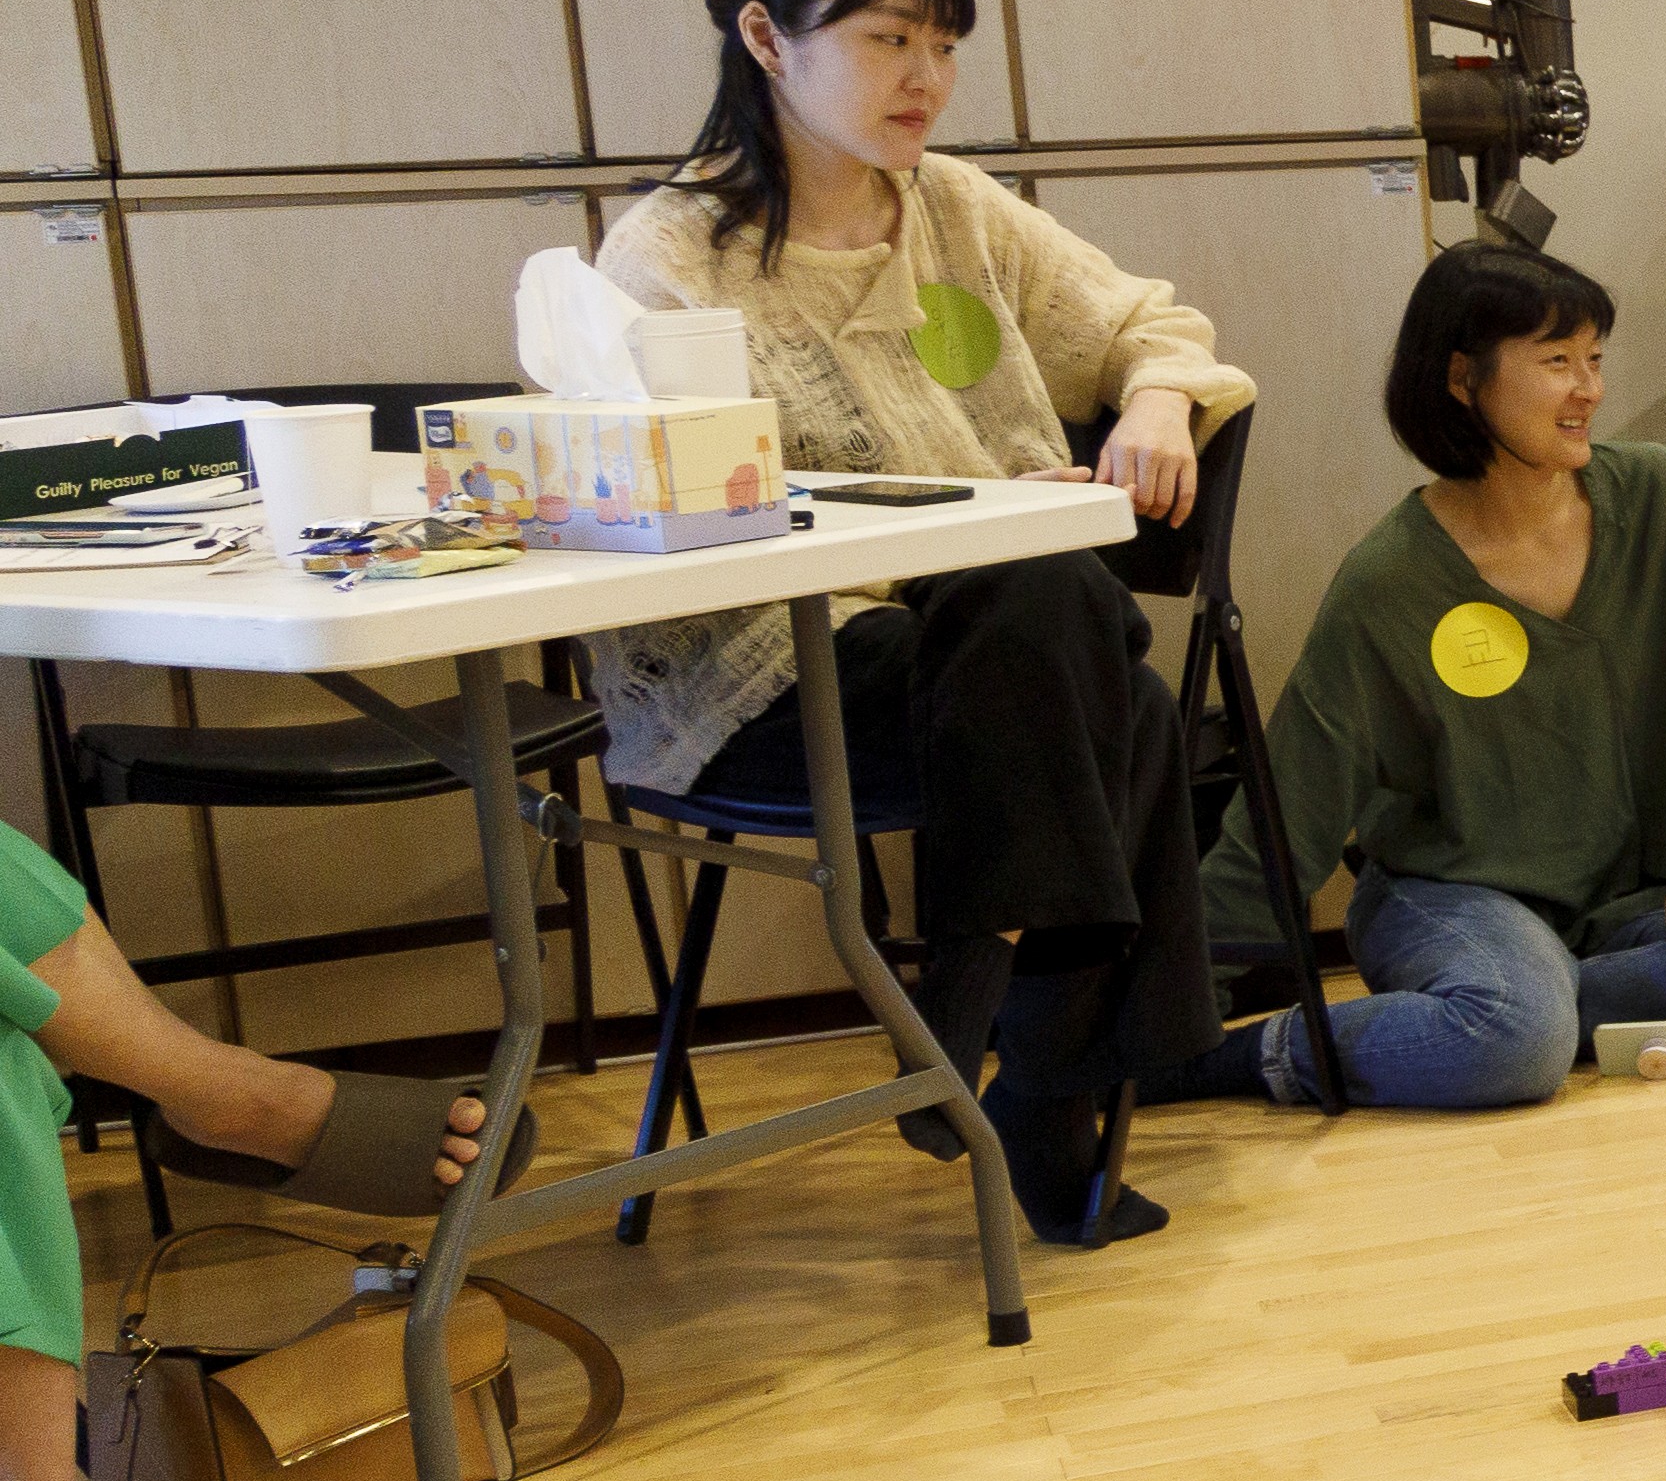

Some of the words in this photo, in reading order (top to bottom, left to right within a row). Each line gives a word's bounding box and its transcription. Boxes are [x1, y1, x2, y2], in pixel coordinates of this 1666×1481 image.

[35, 481, 83, 500] Guilty
[90, 472, 155, 492] Pleasure
[162, 465, 183, 482] for
[189, 459, 239, 478] Vegan
